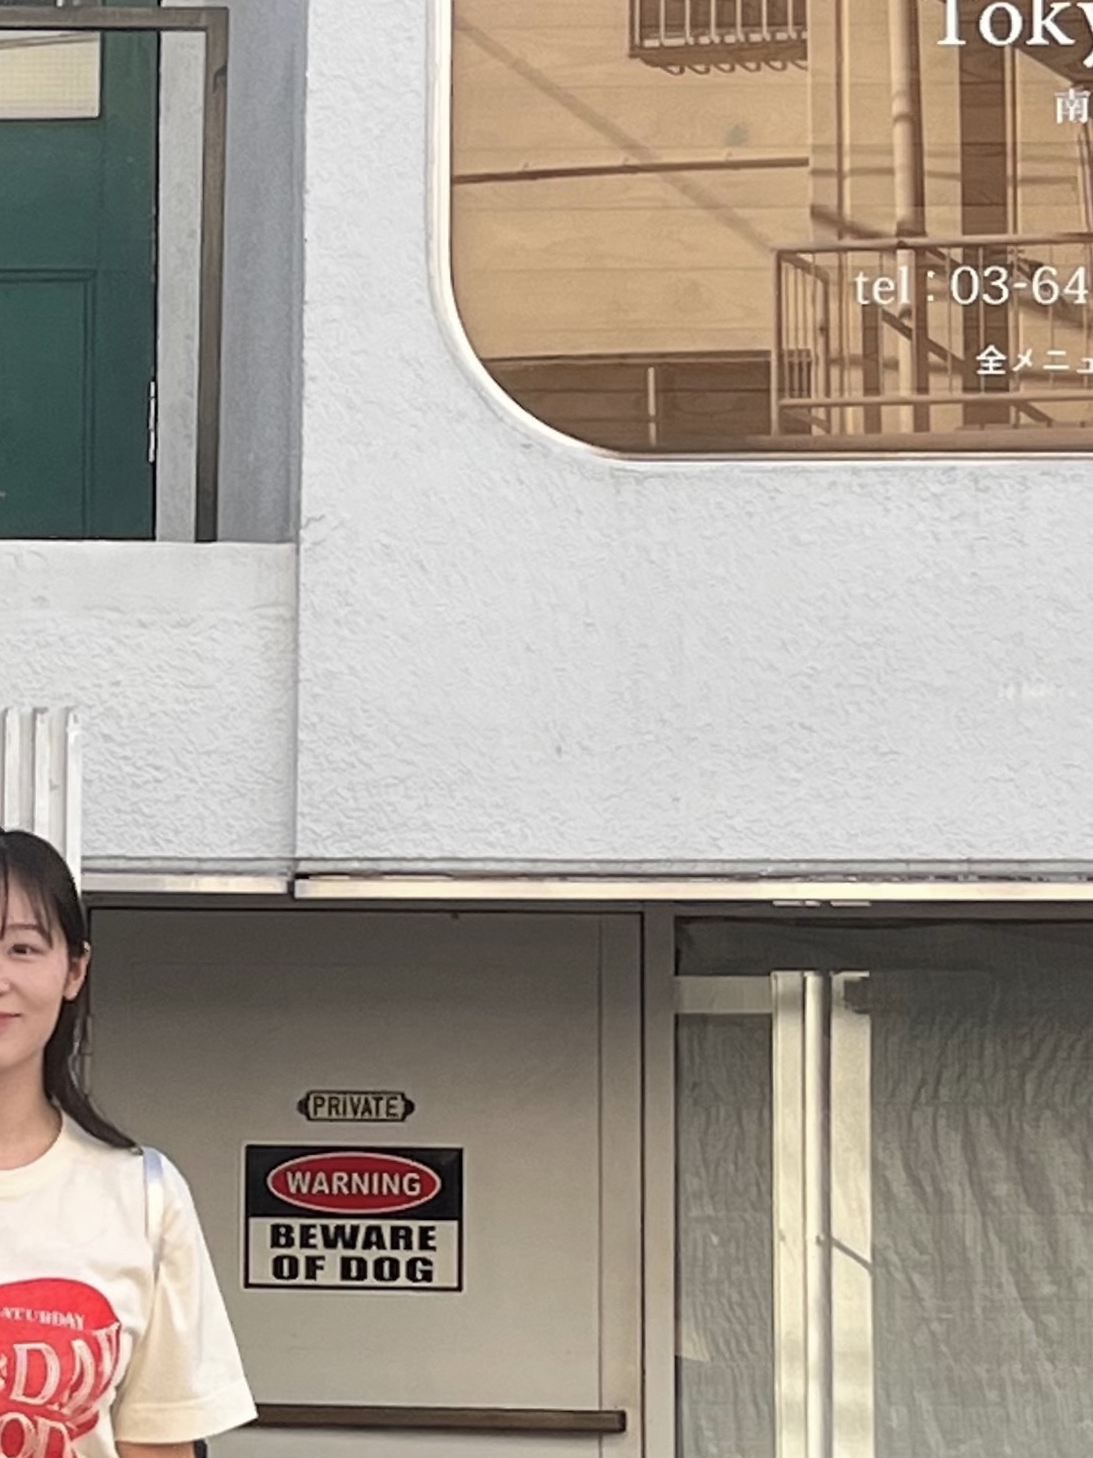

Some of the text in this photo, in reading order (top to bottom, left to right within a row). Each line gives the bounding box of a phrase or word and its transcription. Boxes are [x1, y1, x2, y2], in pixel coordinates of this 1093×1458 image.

[951, 265, 1089, 305] 03-64
[312, 1096, 400, 1118] PRIVATE
[287, 1171, 422, 1197] WARNING
[270, 1223, 437, 1250] BEWARE
[272, 1255, 434, 1283] OF DOG
